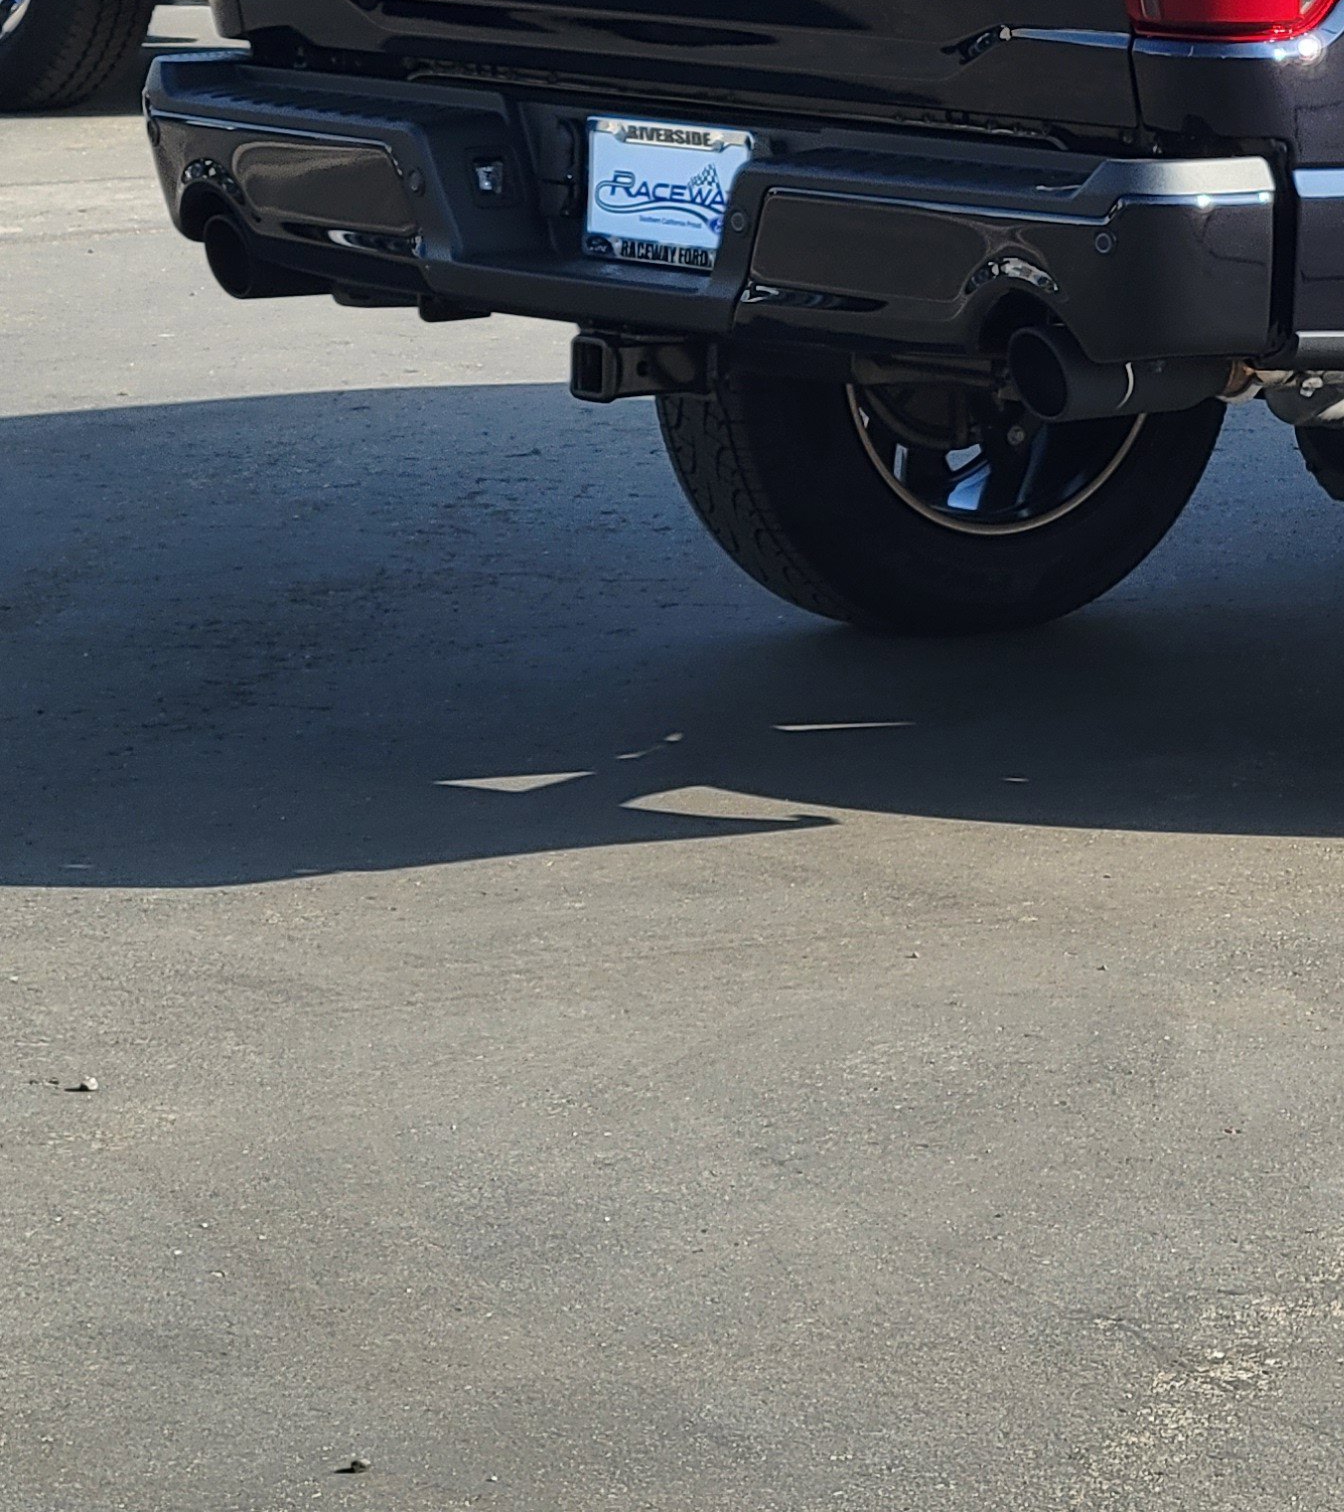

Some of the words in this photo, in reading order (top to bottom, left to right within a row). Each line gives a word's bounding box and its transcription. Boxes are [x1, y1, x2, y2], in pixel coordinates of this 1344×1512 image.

[626, 125, 711, 146] RIVERSIDE
[608, 169, 728, 209] RACEWA
[621, 240, 677, 264] RACEWAY
